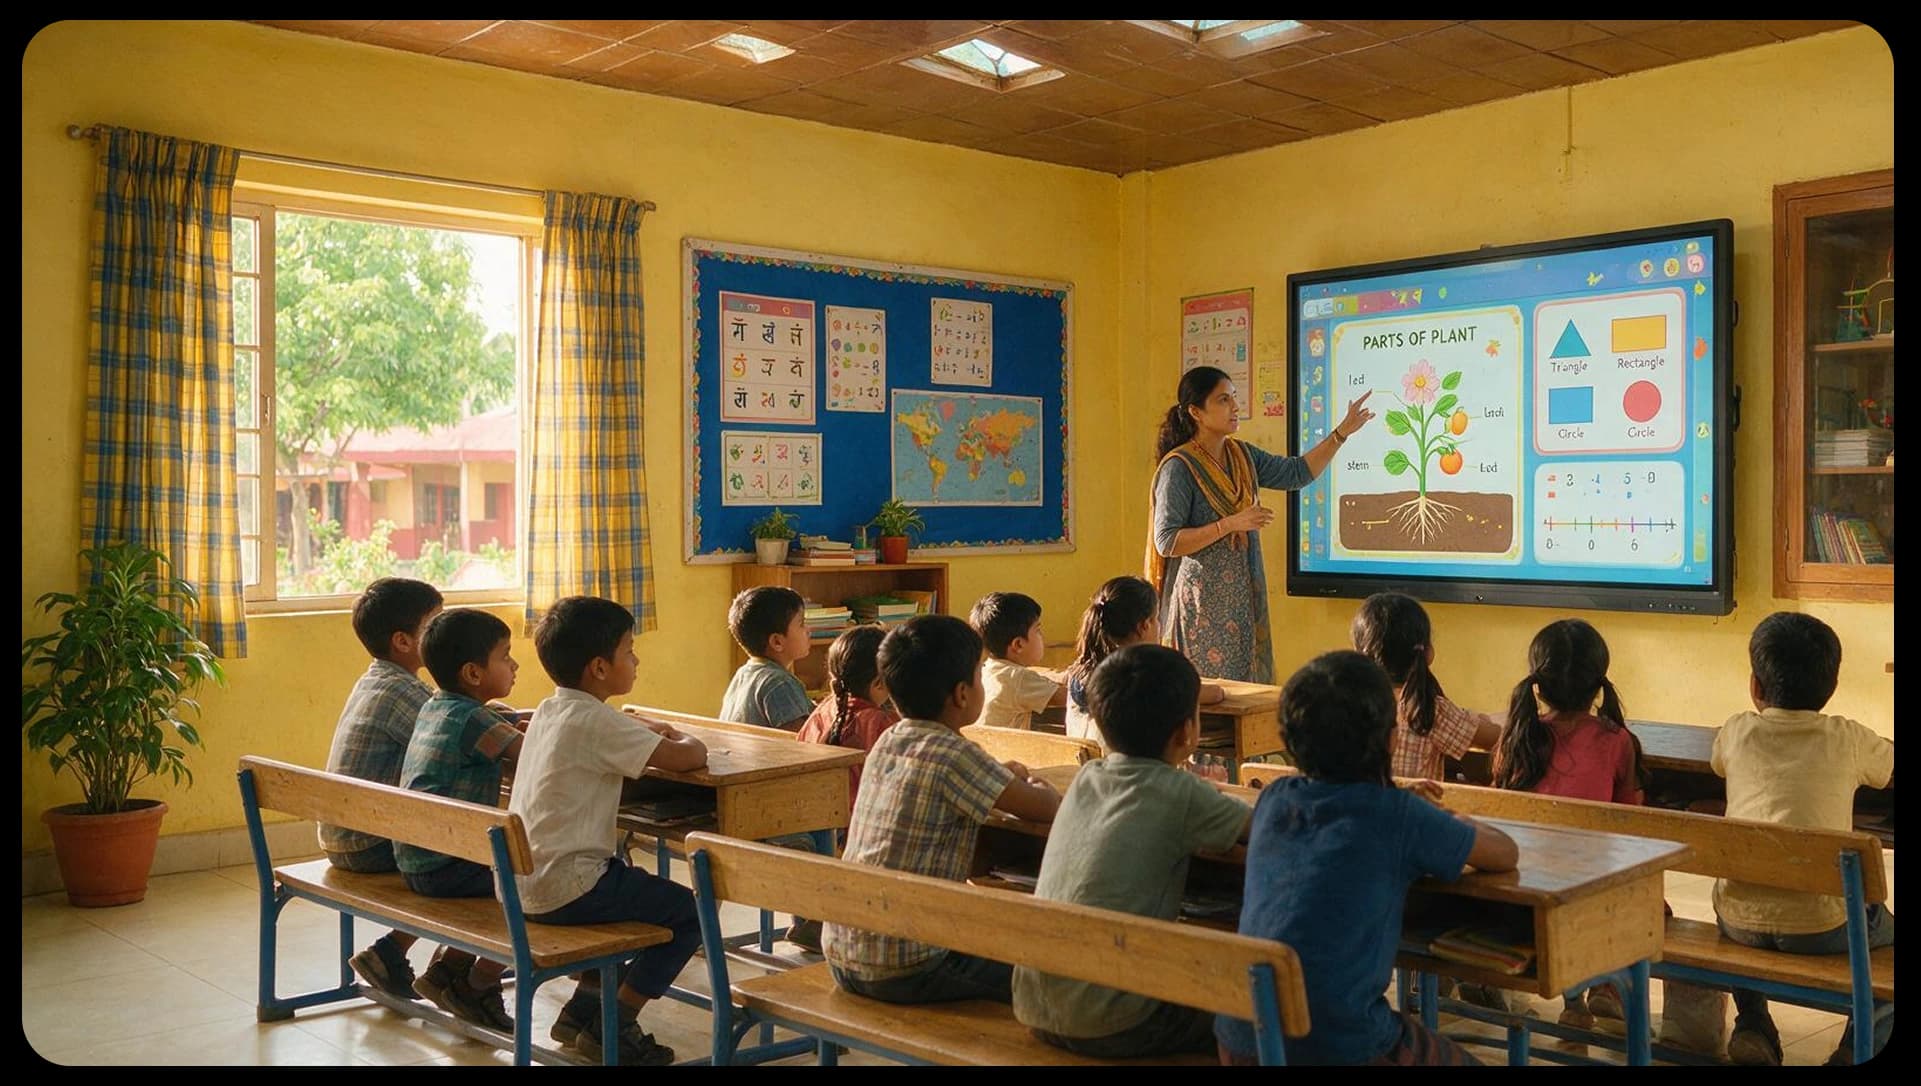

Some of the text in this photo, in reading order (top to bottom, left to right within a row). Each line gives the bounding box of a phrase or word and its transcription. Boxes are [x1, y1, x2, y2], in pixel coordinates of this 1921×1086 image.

[1363, 326, 1477, 350] PARTS OF PLANT
[1550, 360, 1588, 375] Triangle
[1617, 355, 1665, 370] Rectangle
